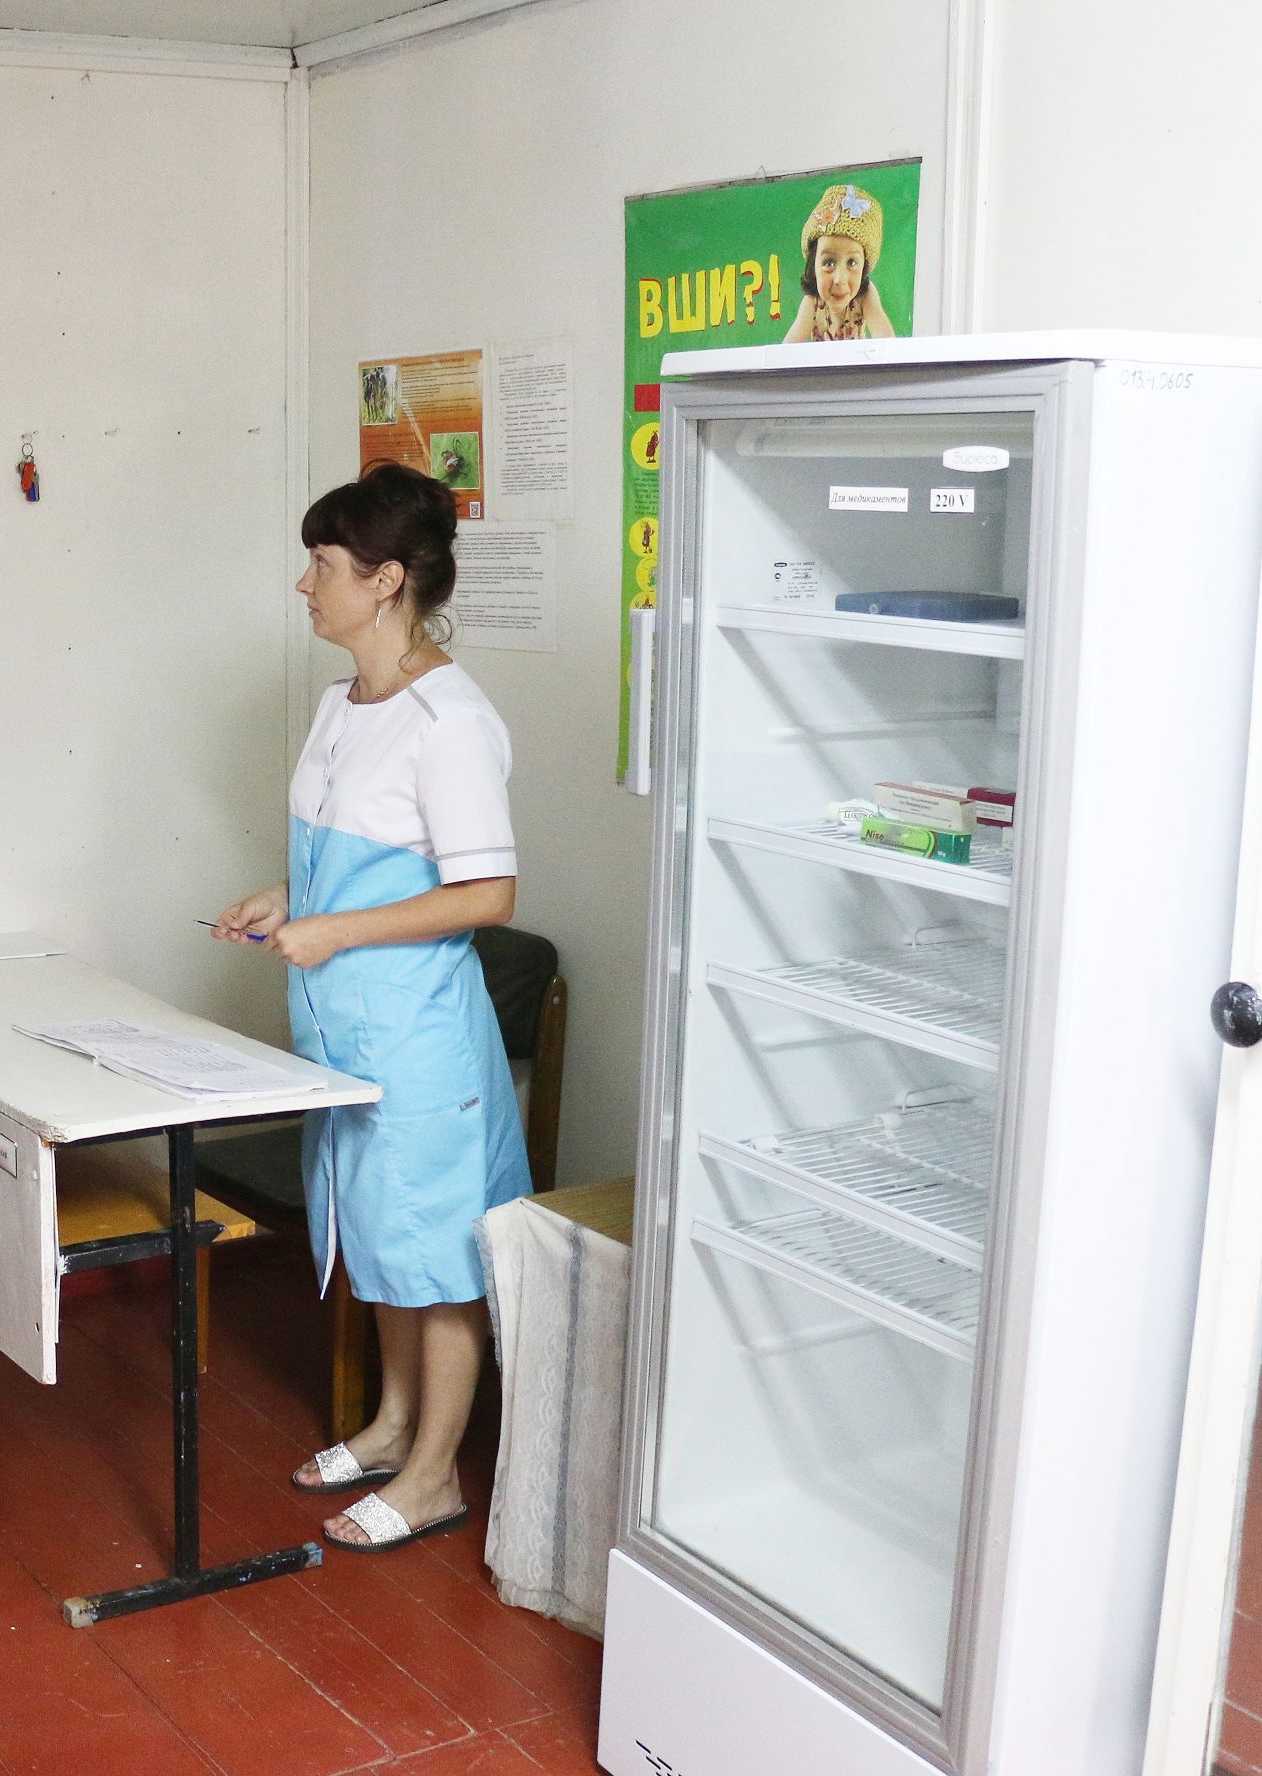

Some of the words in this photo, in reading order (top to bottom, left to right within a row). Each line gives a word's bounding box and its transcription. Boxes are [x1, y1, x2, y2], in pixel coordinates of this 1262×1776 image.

[638, 254, 782, 339] ВШИ?!
[831, 492, 846, 503] Для
[847, 494, 907, 505] медикаментов
[935, 494, 955, 507] 220
[959, 494, 969, 507] V
[865, 829, 885, 841] Nise
